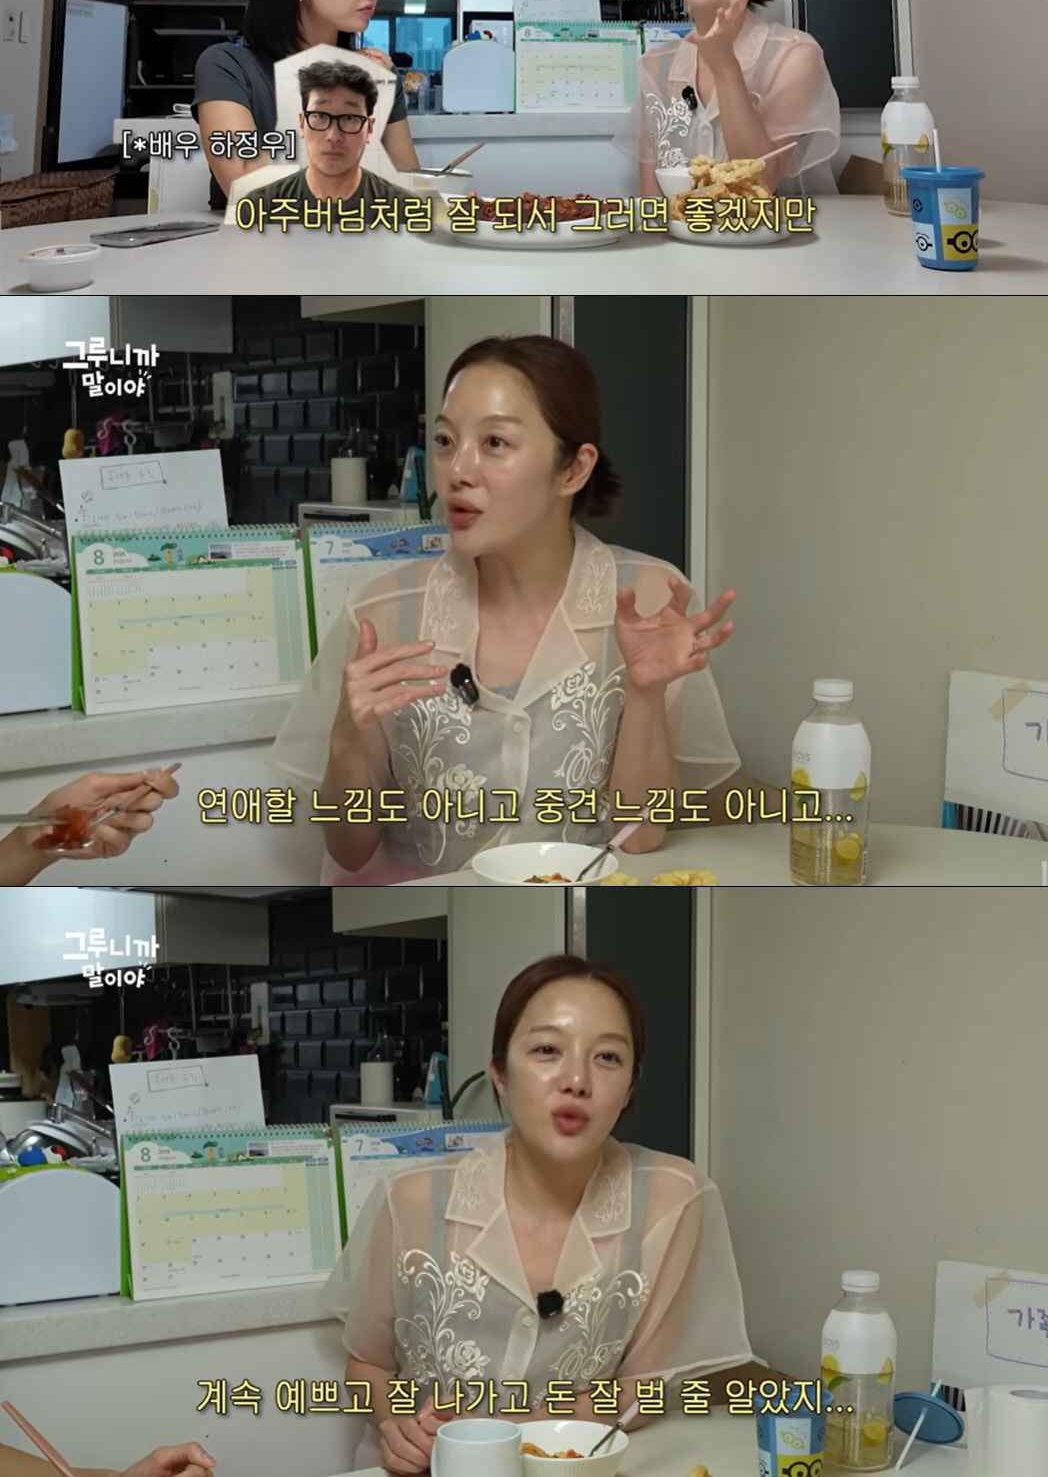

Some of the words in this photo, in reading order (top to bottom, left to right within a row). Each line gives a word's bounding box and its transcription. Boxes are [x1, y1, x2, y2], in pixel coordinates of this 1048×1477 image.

[325, 540, 334, 555] 7
[94, 549, 105, 566] 8
[355, 1139, 363, 1153] 7
[141, 1147, 151, 1162] 8
